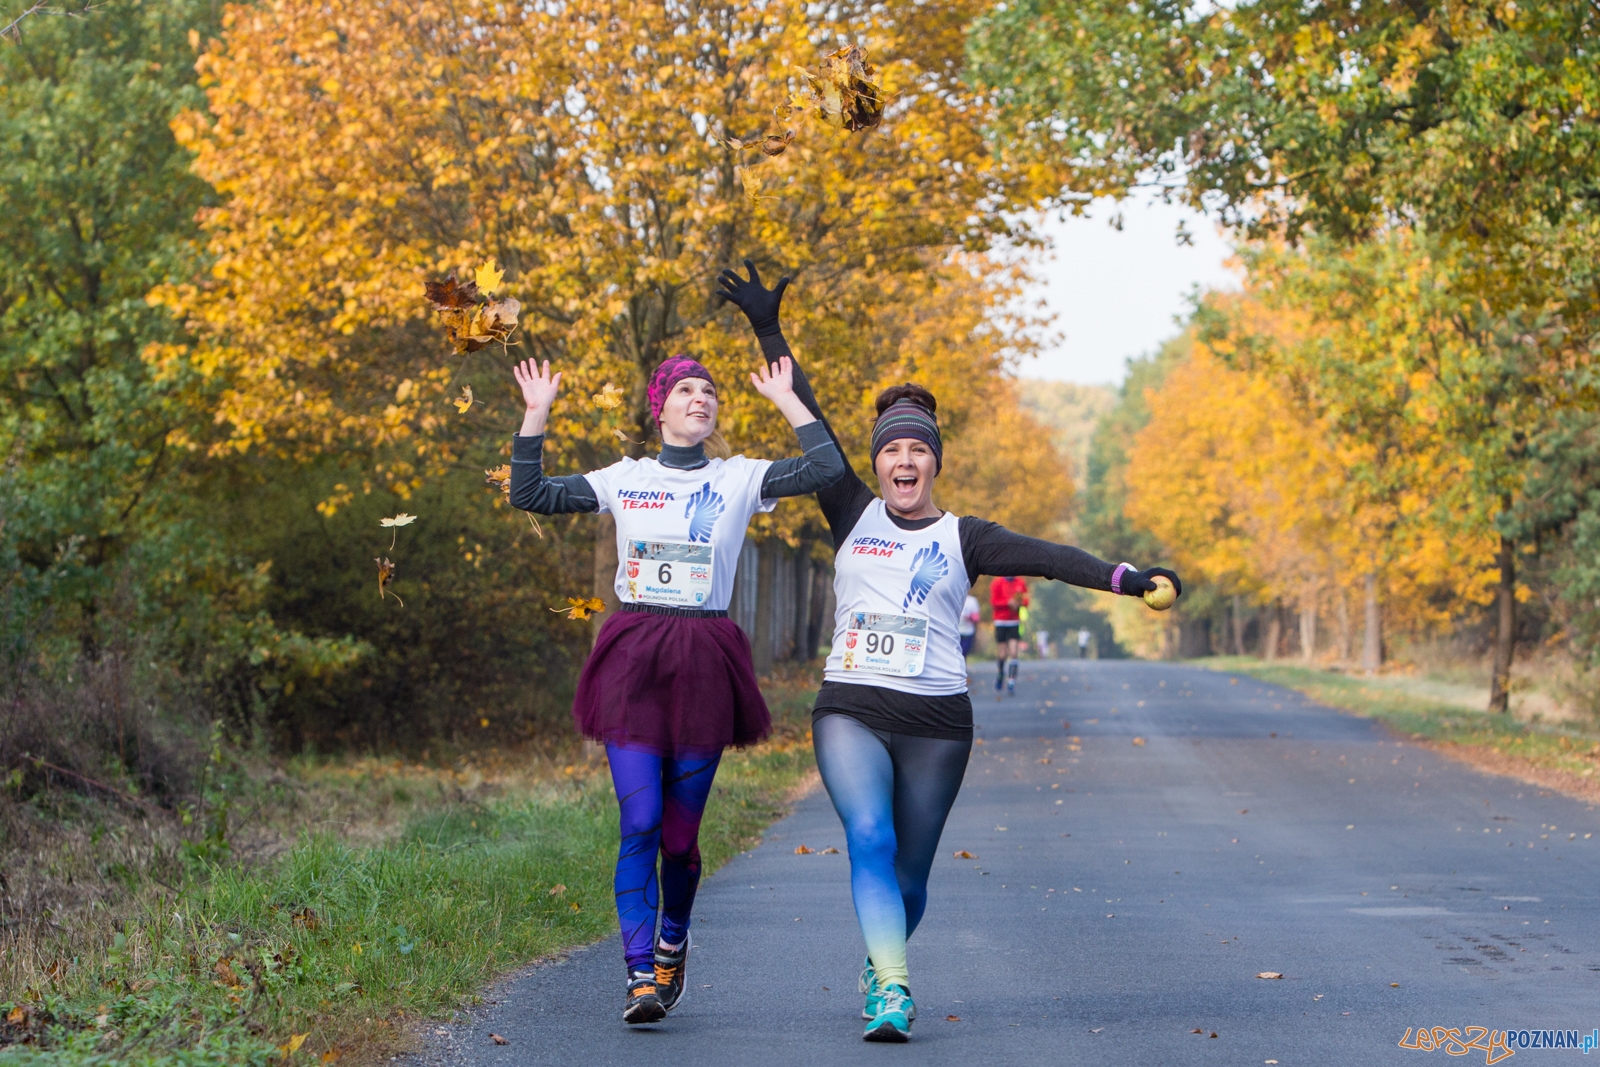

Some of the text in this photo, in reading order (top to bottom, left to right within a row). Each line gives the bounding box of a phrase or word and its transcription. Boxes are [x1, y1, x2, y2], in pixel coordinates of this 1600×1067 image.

[617, 489, 676, 501] HERNIK
[622, 499, 665, 510] TEAM
[851, 537, 906, 550] HERNIK
[852, 546, 893, 558] TEAM
[658, 562, 672, 585] 6
[645, 585, 682, 594] Magdalena
[866, 632, 895, 656] 90
[865, 656, 890, 664] Ewelina
